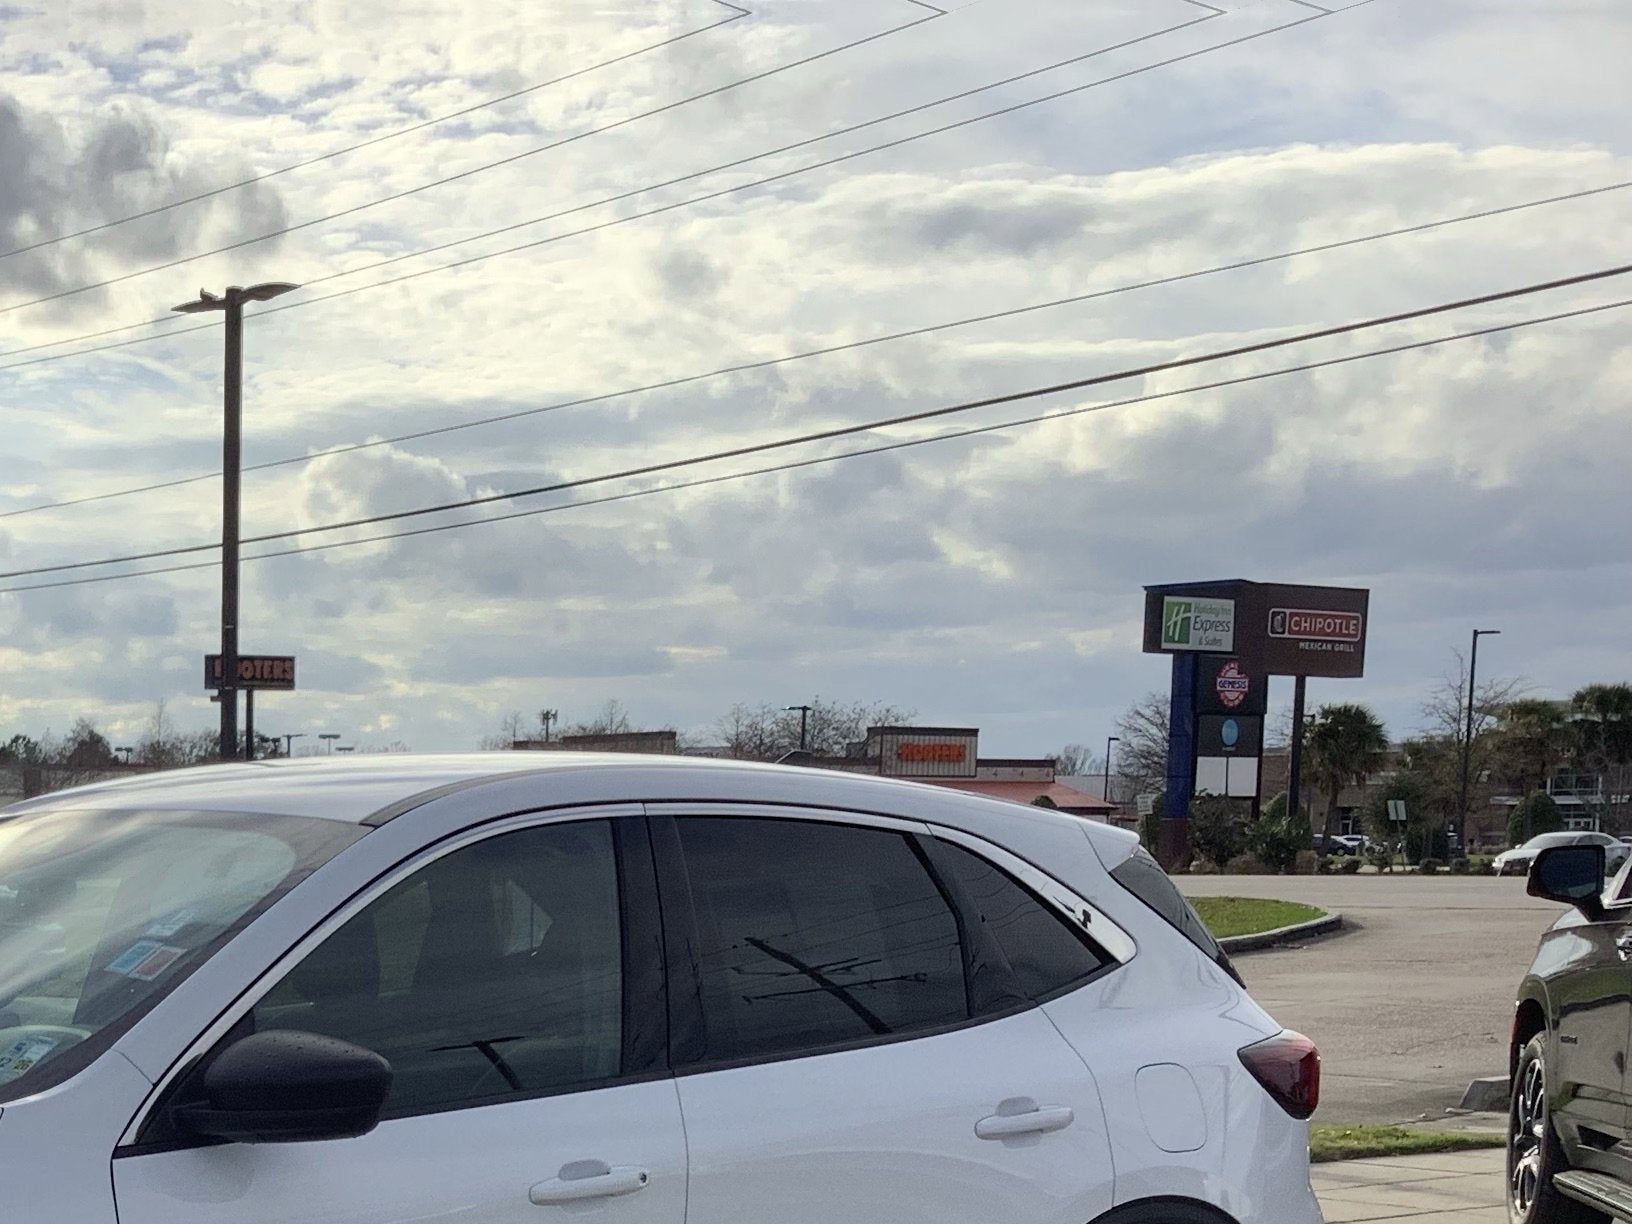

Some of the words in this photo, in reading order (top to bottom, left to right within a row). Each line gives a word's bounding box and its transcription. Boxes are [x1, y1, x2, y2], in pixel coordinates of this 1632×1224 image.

[1193, 615, 1231, 634] Express
[1290, 616, 1358, 634] CHIPOTLE
[1299, 642, 1331, 651] MEXICAN
[1334, 643, 1355, 652] GRILL
[1218, 680, 1247, 689] GENESIS
